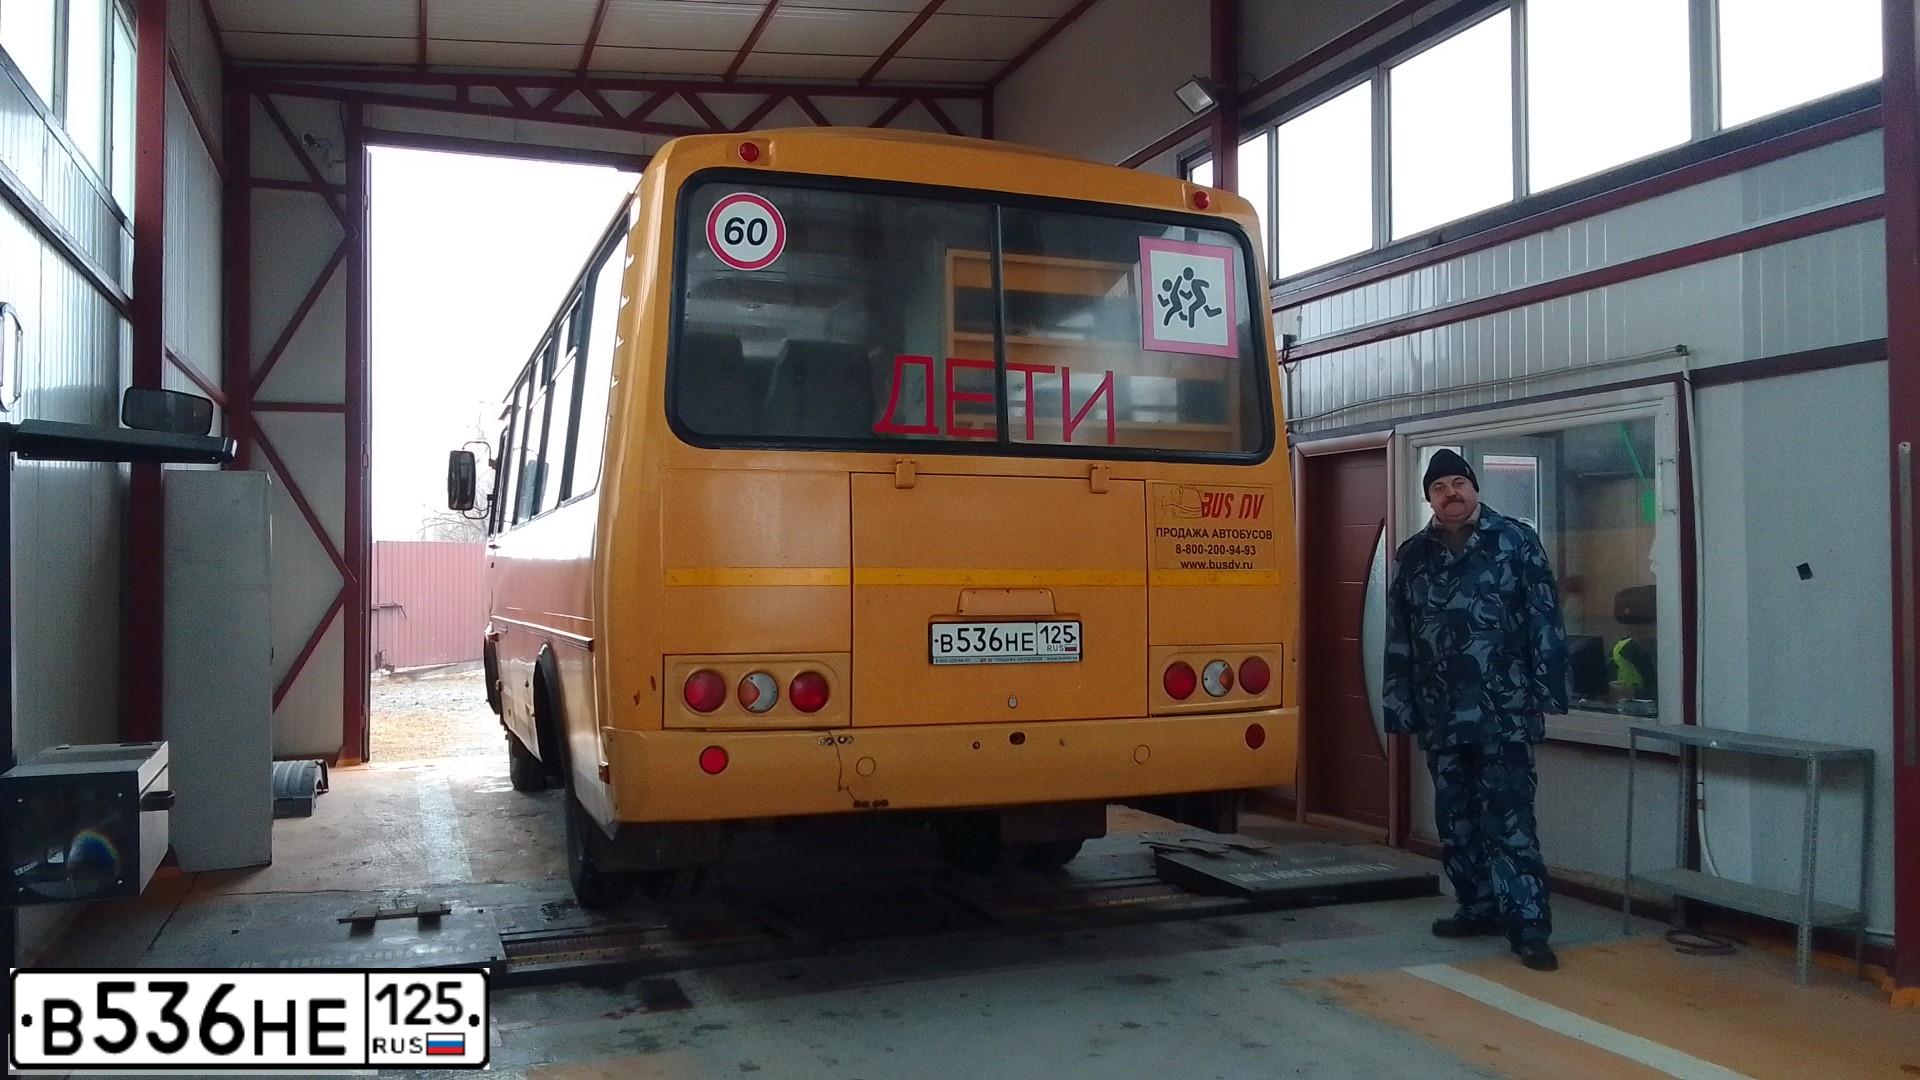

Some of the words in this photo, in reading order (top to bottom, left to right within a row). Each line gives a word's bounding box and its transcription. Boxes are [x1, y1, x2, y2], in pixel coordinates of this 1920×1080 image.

[724, 216, 768, 246] 60
[873, 354, 1116, 445] ДЕТИ
[1200, 491, 1235, 519] BUS
[1155, 527, 1209, 539] ПРОДАЖА
[1211, 528, 1273, 540] АВТОБУСОВ
[1175, 543, 1257, 556] 8-800-200-94-93
[1180, 559, 1254, 570] www.busdv.ru
[1039, 624, 1075, 644] 125
[1046, 644, 1064, 652] RUS
